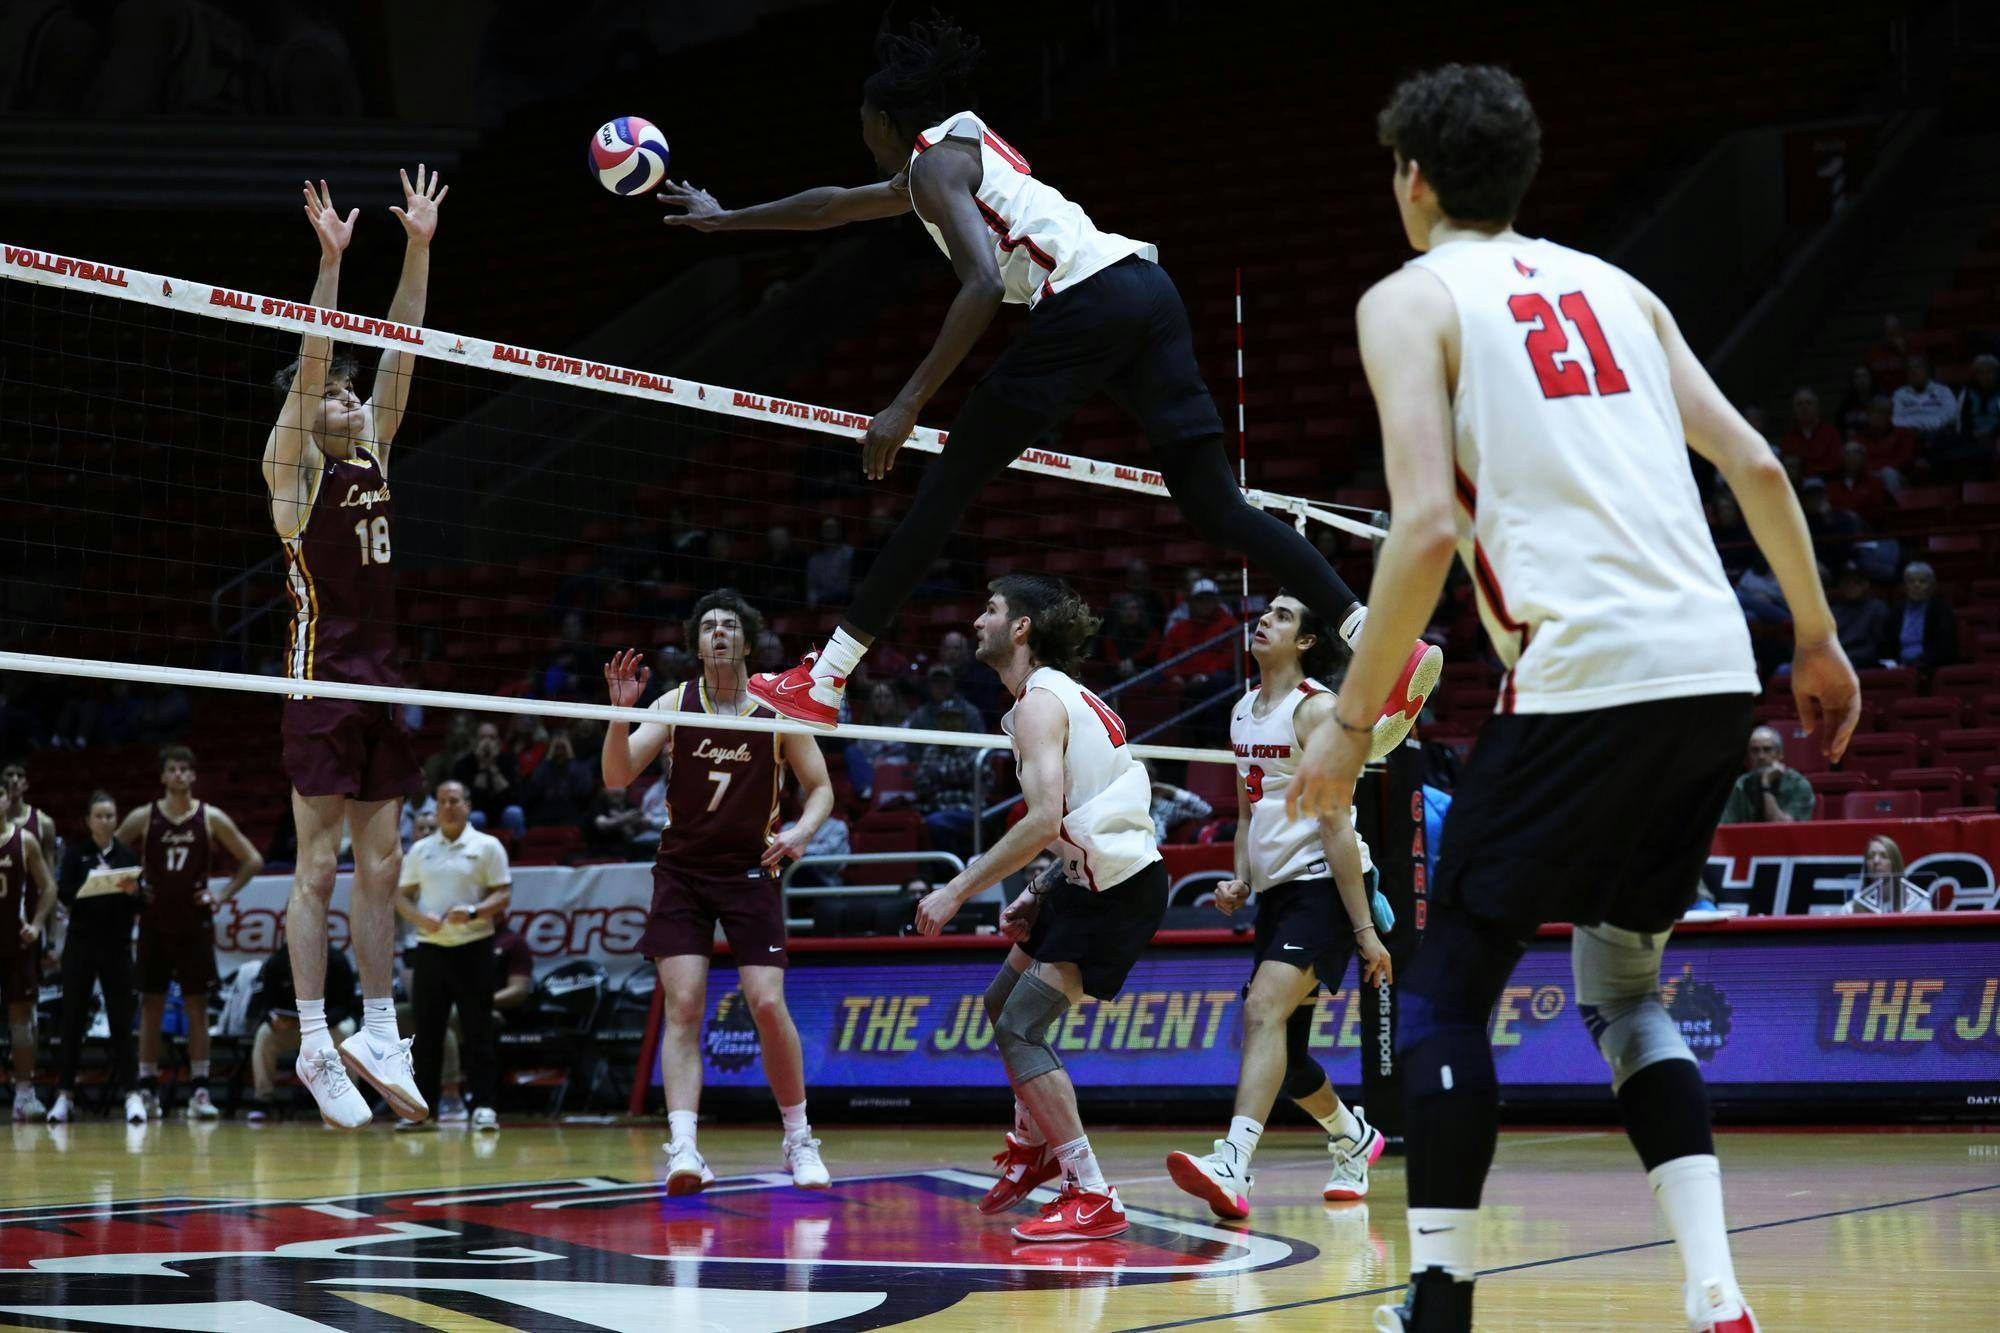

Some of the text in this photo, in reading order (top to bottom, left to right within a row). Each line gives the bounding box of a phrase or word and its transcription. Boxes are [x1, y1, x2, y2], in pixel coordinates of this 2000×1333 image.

[4, 246, 129, 287] VOLLEYBALL
[209, 288, 425, 346] BALL STATE VOLLEYBALL
[1507, 290, 1631, 399] 21
[492, 345, 674, 393] BALL STATE VOLLEYBALL
[733, 392, 767, 411] BALL
[769, 399, 810, 419] STATE
[1114, 466, 1165, 486] BALL STAT
[354, 516, 391, 567] 18
[692, 738, 752, 764] Loyola
[1232, 743, 1291, 758] ALL STATE
[706, 770, 732, 812] 7
[1245, 764, 1265, 803] 3
[166, 846, 189, 871] 17
[839, 996, 931, 1051] THE
[934, 991, 1237, 1051] JUEMENT
[1833, 978, 2000, 1042] THE J
[1378, 1016, 1393, 1077] imports
[1967, 1095, 2000, 1105] DAKT
